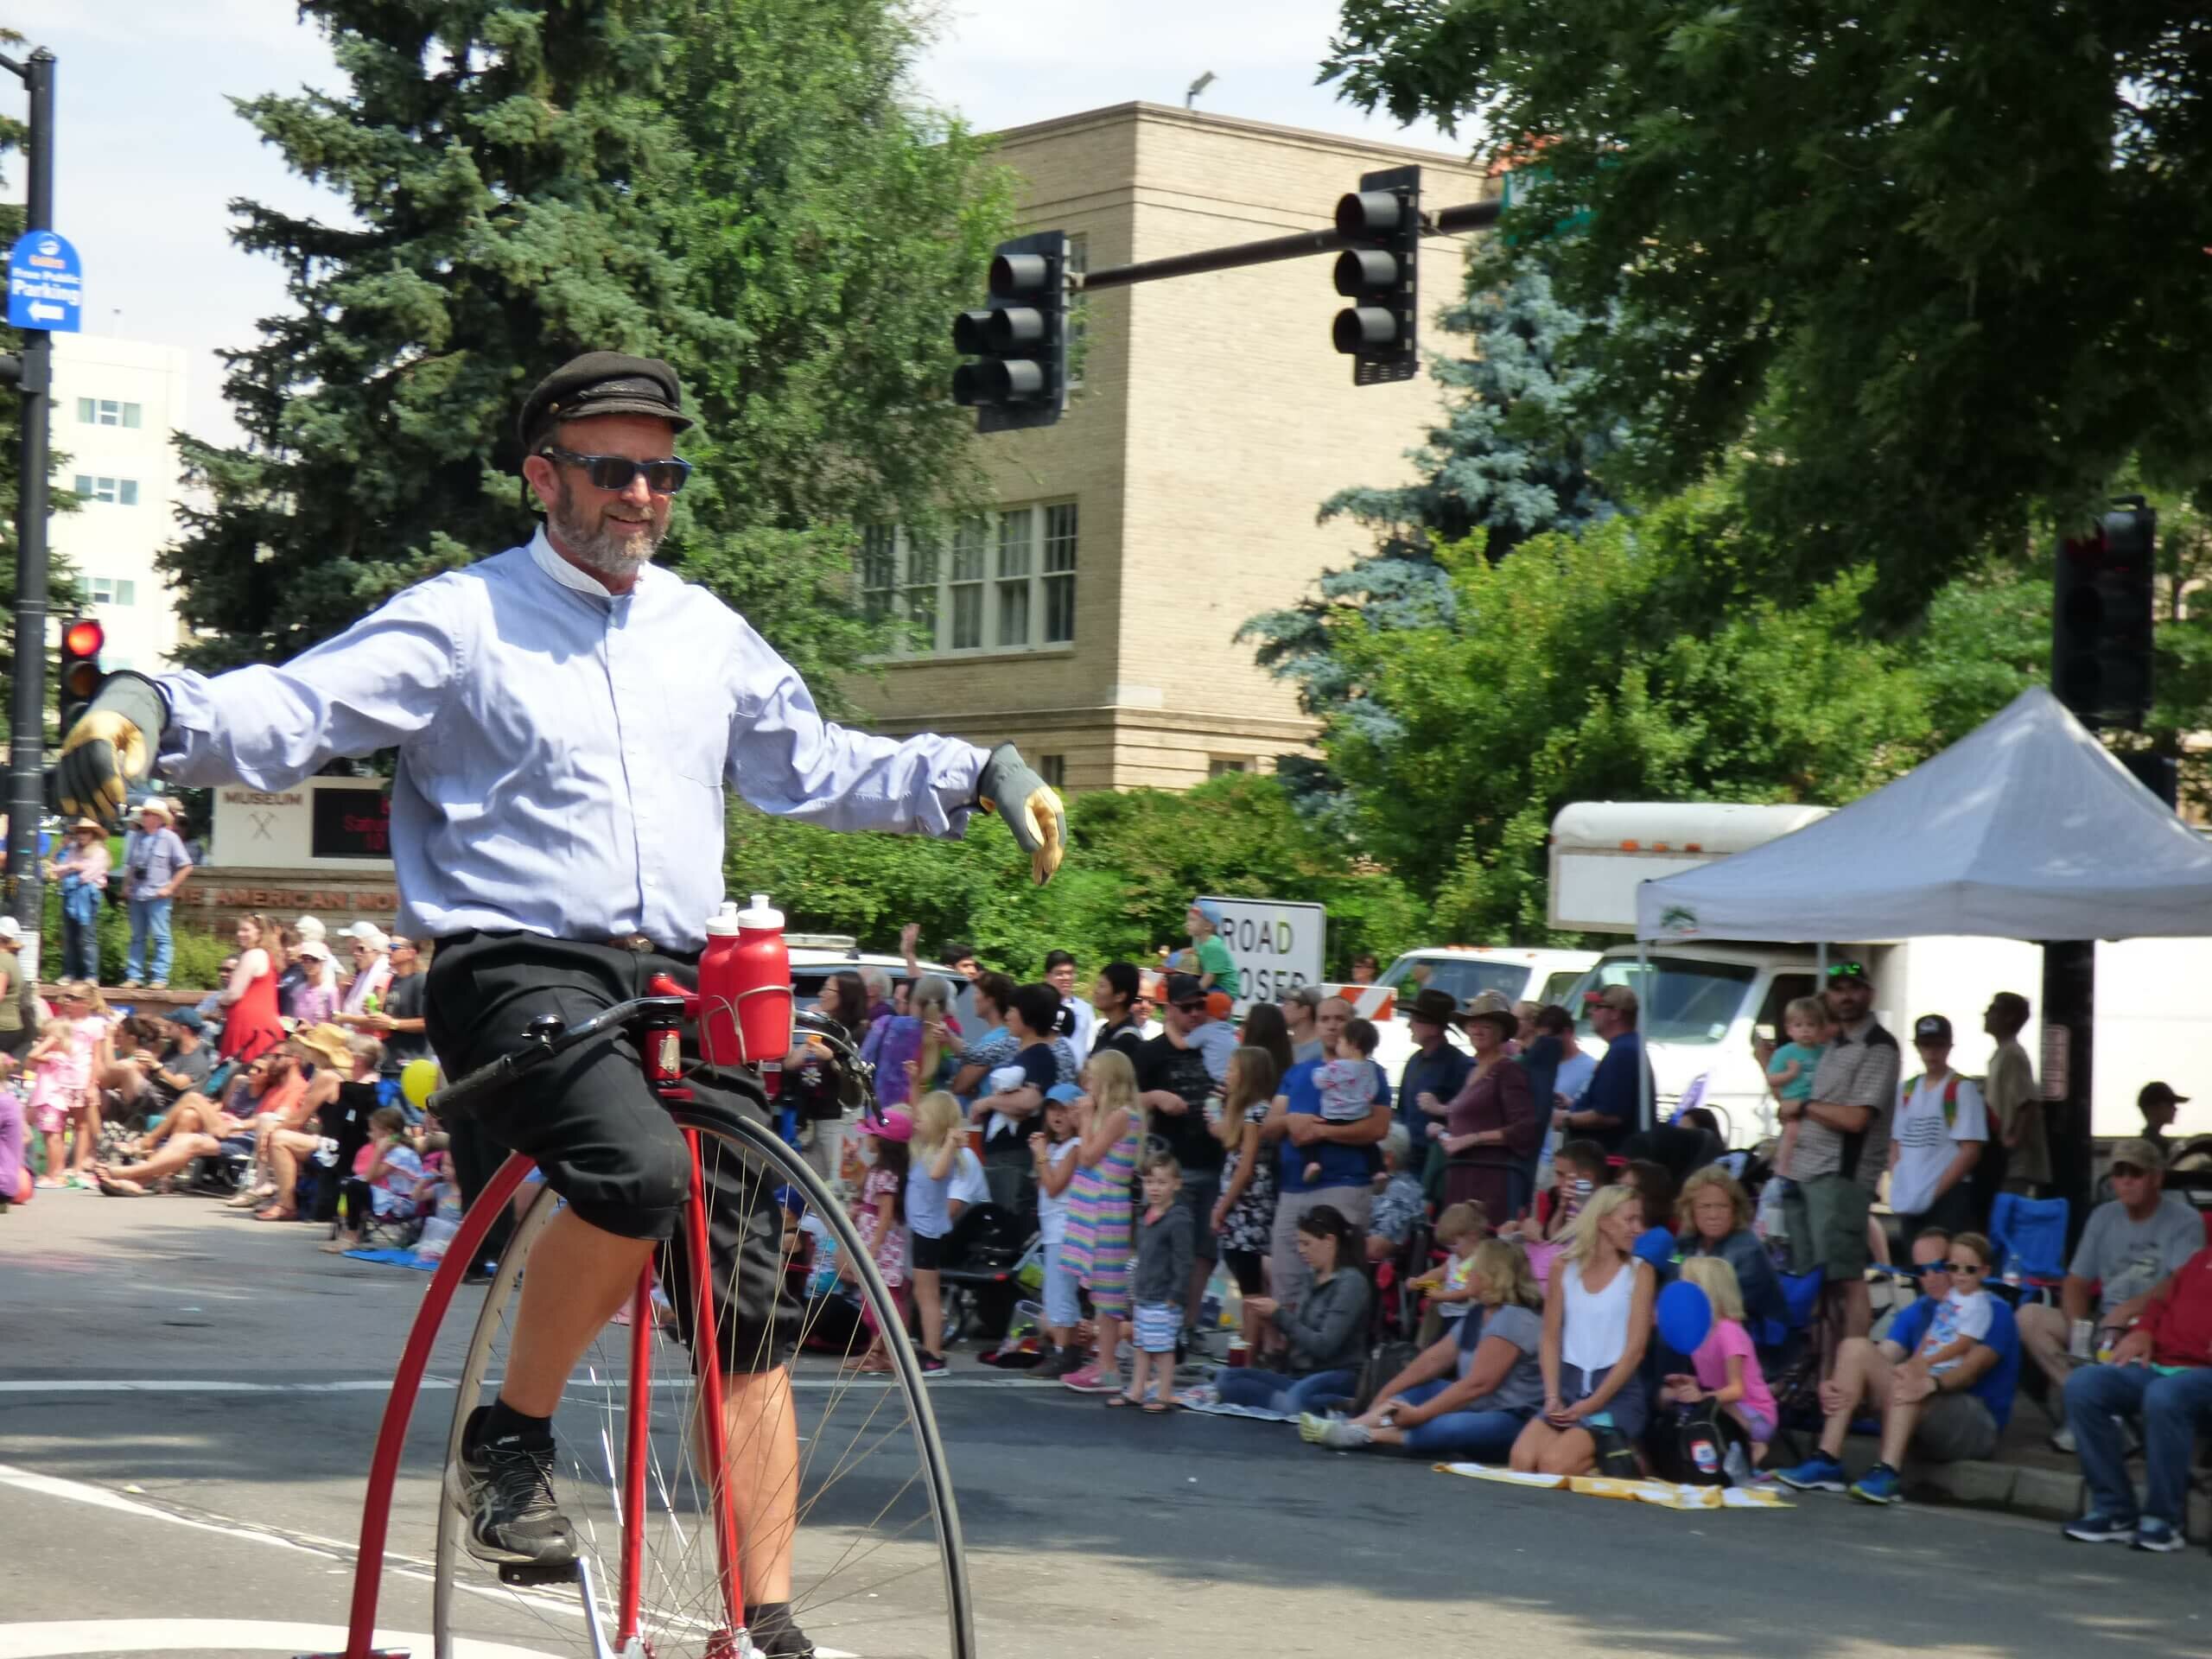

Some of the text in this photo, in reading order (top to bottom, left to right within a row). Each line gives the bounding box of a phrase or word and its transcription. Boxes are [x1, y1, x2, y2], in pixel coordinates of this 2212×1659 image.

[11, 278, 82, 306] Parking
[222, 791, 303, 805] MUSEUM
[216, 887, 346, 908] AMERICAN
[1222, 918, 1294, 955] ROAD
